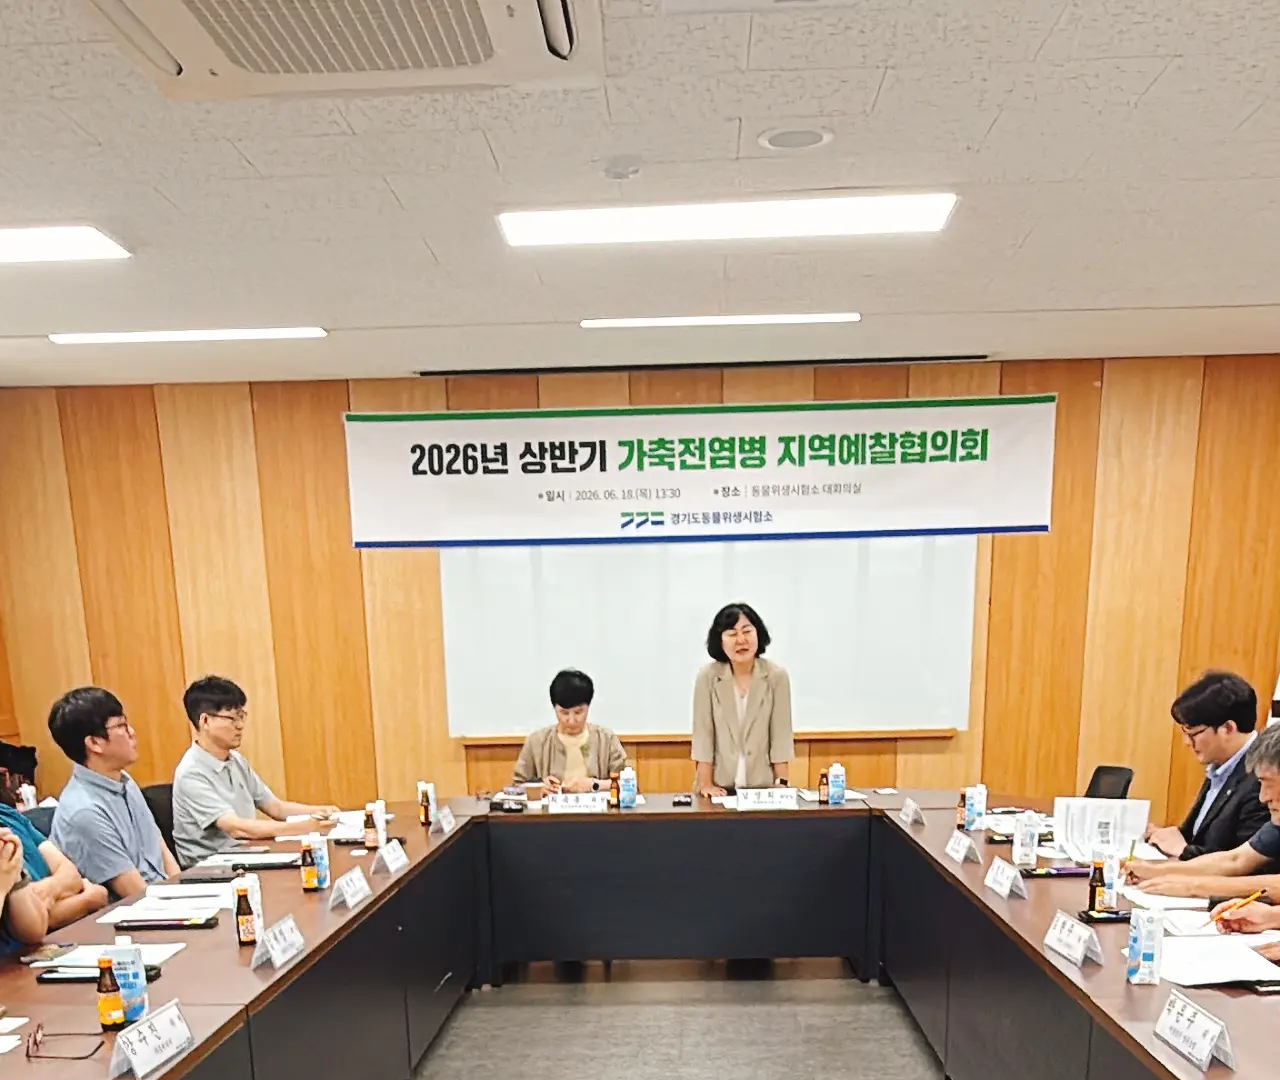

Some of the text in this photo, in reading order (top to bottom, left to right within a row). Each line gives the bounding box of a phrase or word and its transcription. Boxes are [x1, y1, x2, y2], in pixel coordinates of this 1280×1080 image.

[410, 428, 989, 476] 2026년 상반기 가축전염병 지역예찰협의회
[545, 490, 565, 501] 일시
[575, 490, 602, 501] 2026.
[604, 490, 619, 500] 06.
[655, 488, 681, 499] 13:30
[721, 483, 862, 498] 장소 동물위생시험소 대회의실
[670, 511, 774, 525] 경기도동물위생시험소
